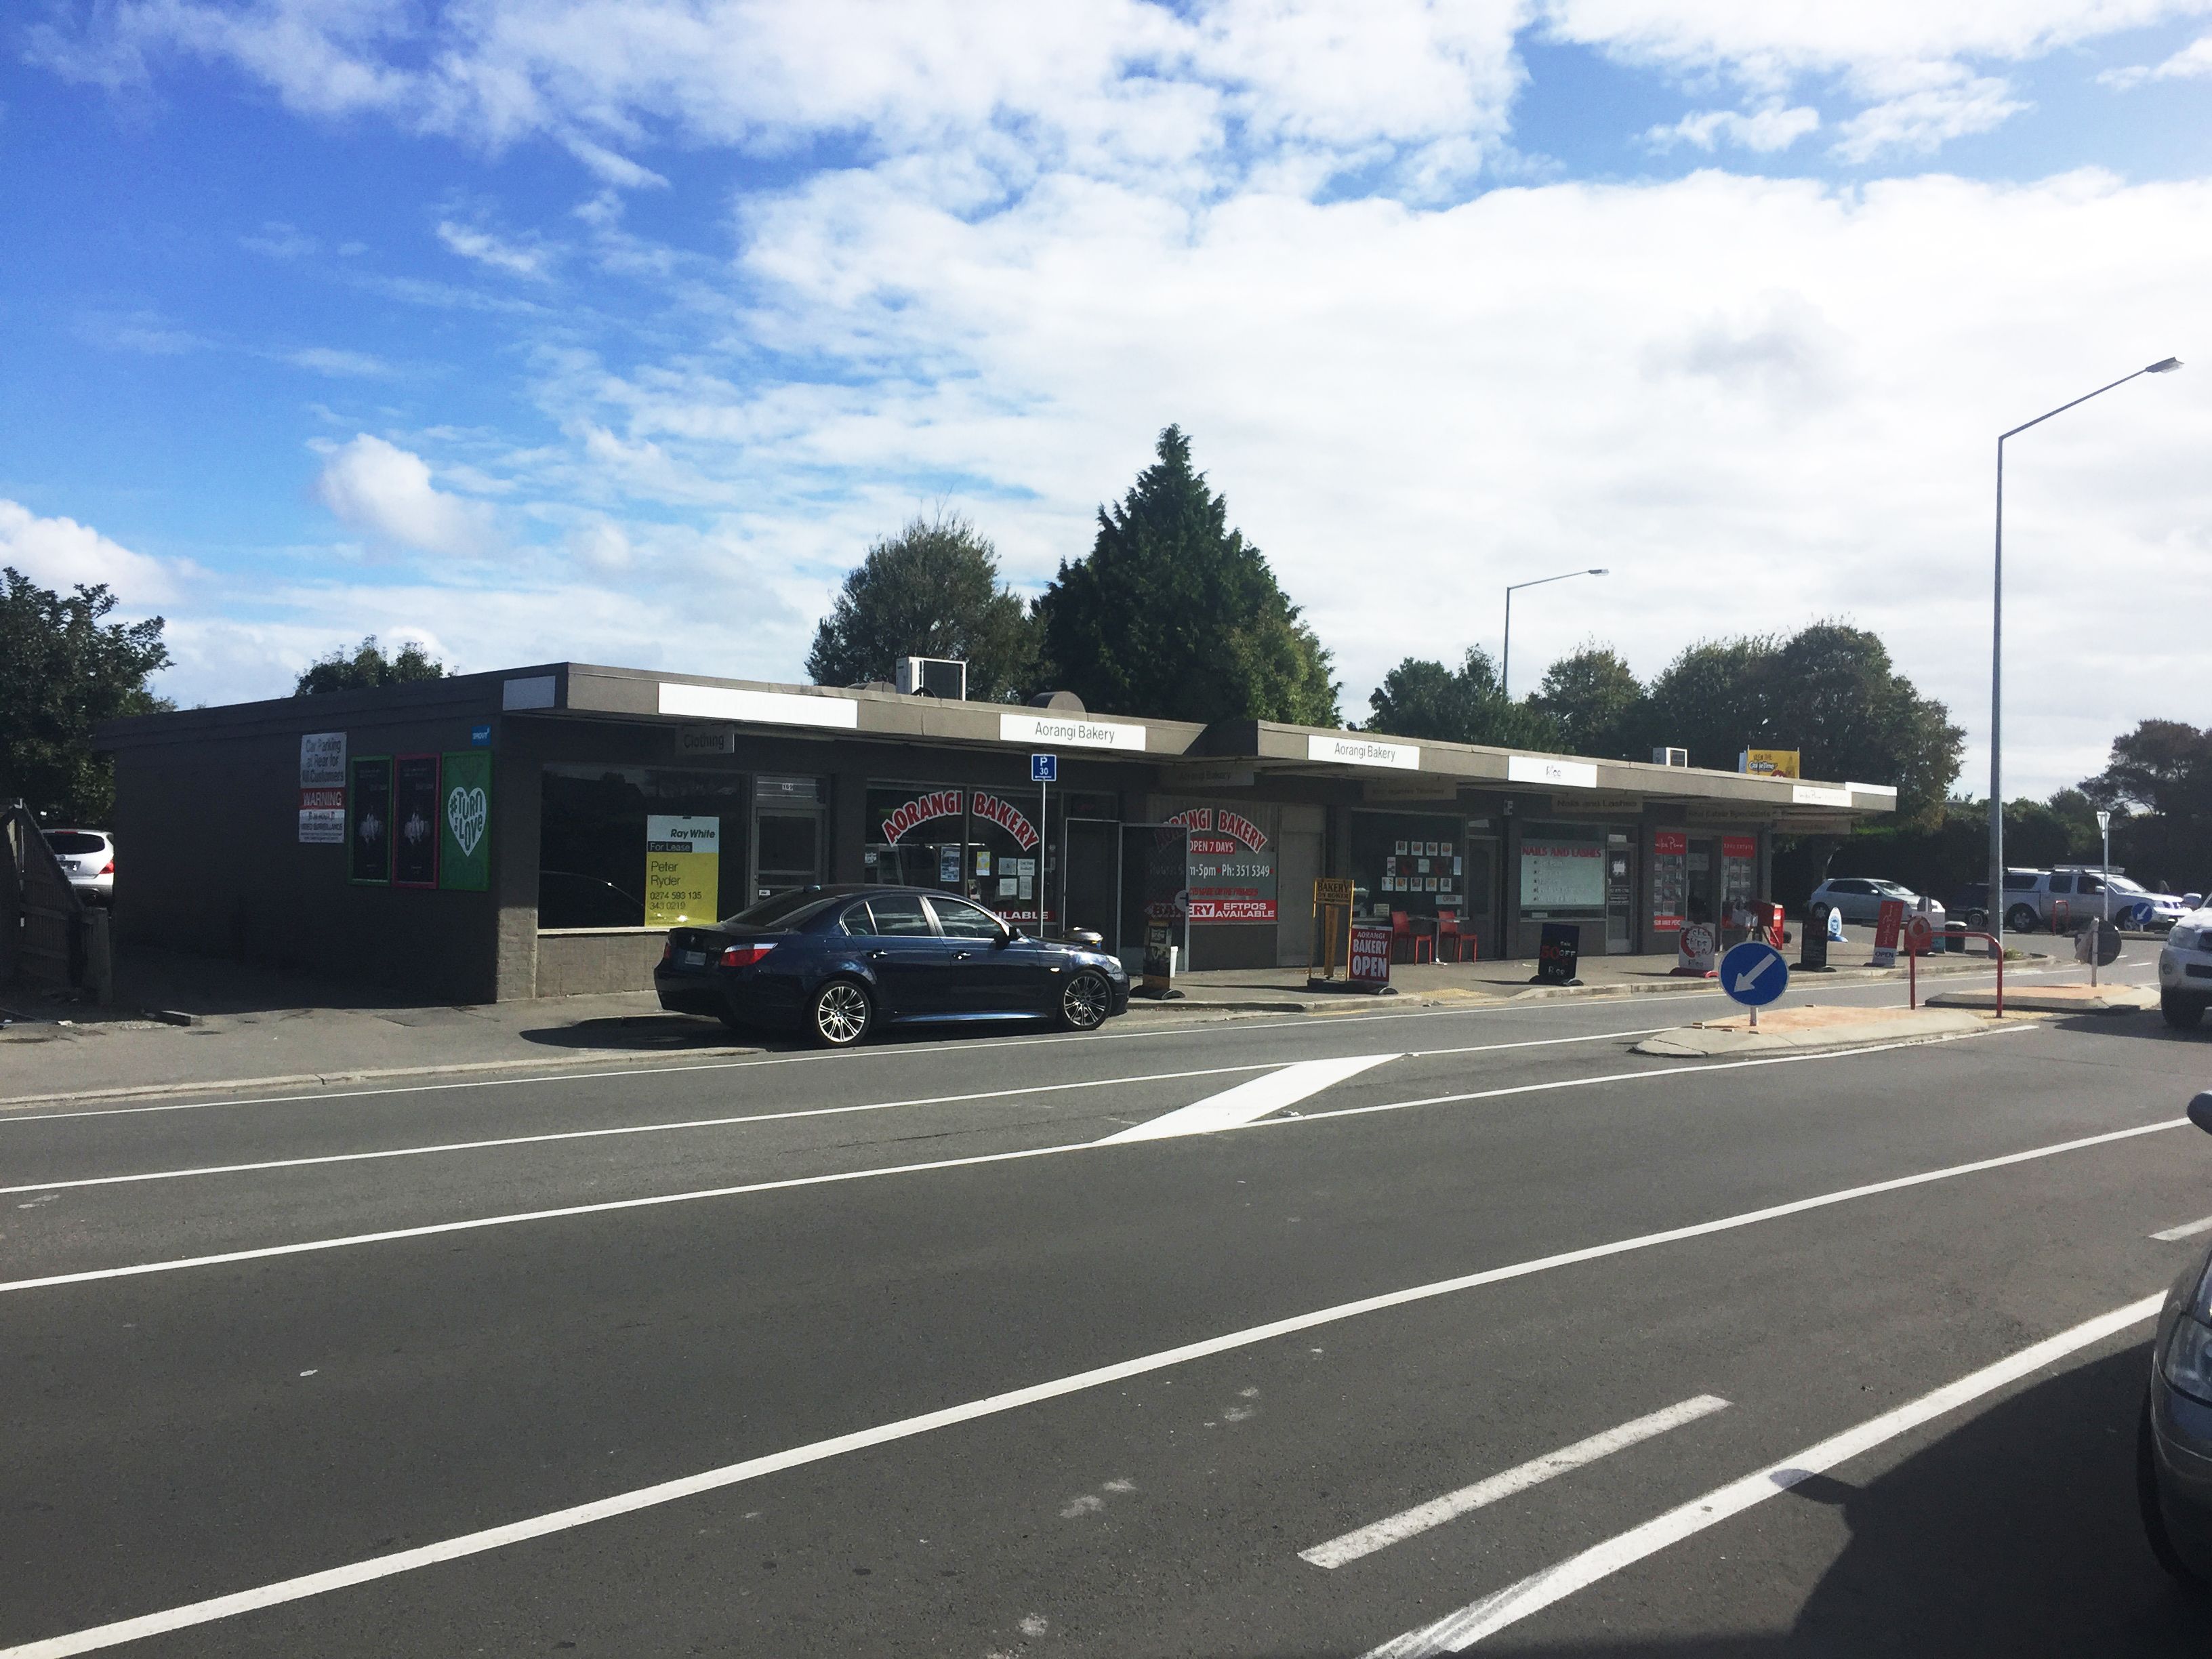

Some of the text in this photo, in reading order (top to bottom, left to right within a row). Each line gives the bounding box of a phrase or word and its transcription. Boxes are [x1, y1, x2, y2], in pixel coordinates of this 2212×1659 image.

[1036, 721, 1115, 743] Aorangi Bakery
[683, 733, 724, 750] Clothing
[1334, 742, 1395, 762] Aorangi Bakery
[1040, 757, 1048, 766] P
[1040, 767, 1048, 775] 30
[304, 792, 342, 806] WARNING
[881, 790, 1040, 853] AORANGI BAKERY
[670, 828, 716, 839] Ray White
[1218, 809, 1268, 854] BAKERY
[650, 842, 690, 852] For Lease
[1210, 841, 1214, 852] 7
[1216, 841, 1233, 853] DAYS
[1521, 846, 1547, 857] NAILS
[1551, 847, 1569, 857] AND
[651, 861, 678, 872] Peter
[1221, 863, 1234, 876] Ph:
[1236, 865, 1249, 876] 351
[1251, 865, 1270, 877] 5349
[651, 875, 680, 888] Ryder
[1317, 882, 1349, 893] BAKERY
[650, 891, 702, 900] 0274 593 135
[993, 911, 1048, 920] ILABLE
[1357, 931, 1385, 939] AORANGI
[1353, 939, 1388, 955] BAKERY
[1559, 949, 1576, 958] OFF
[1352, 955, 1387, 978] OPEN
